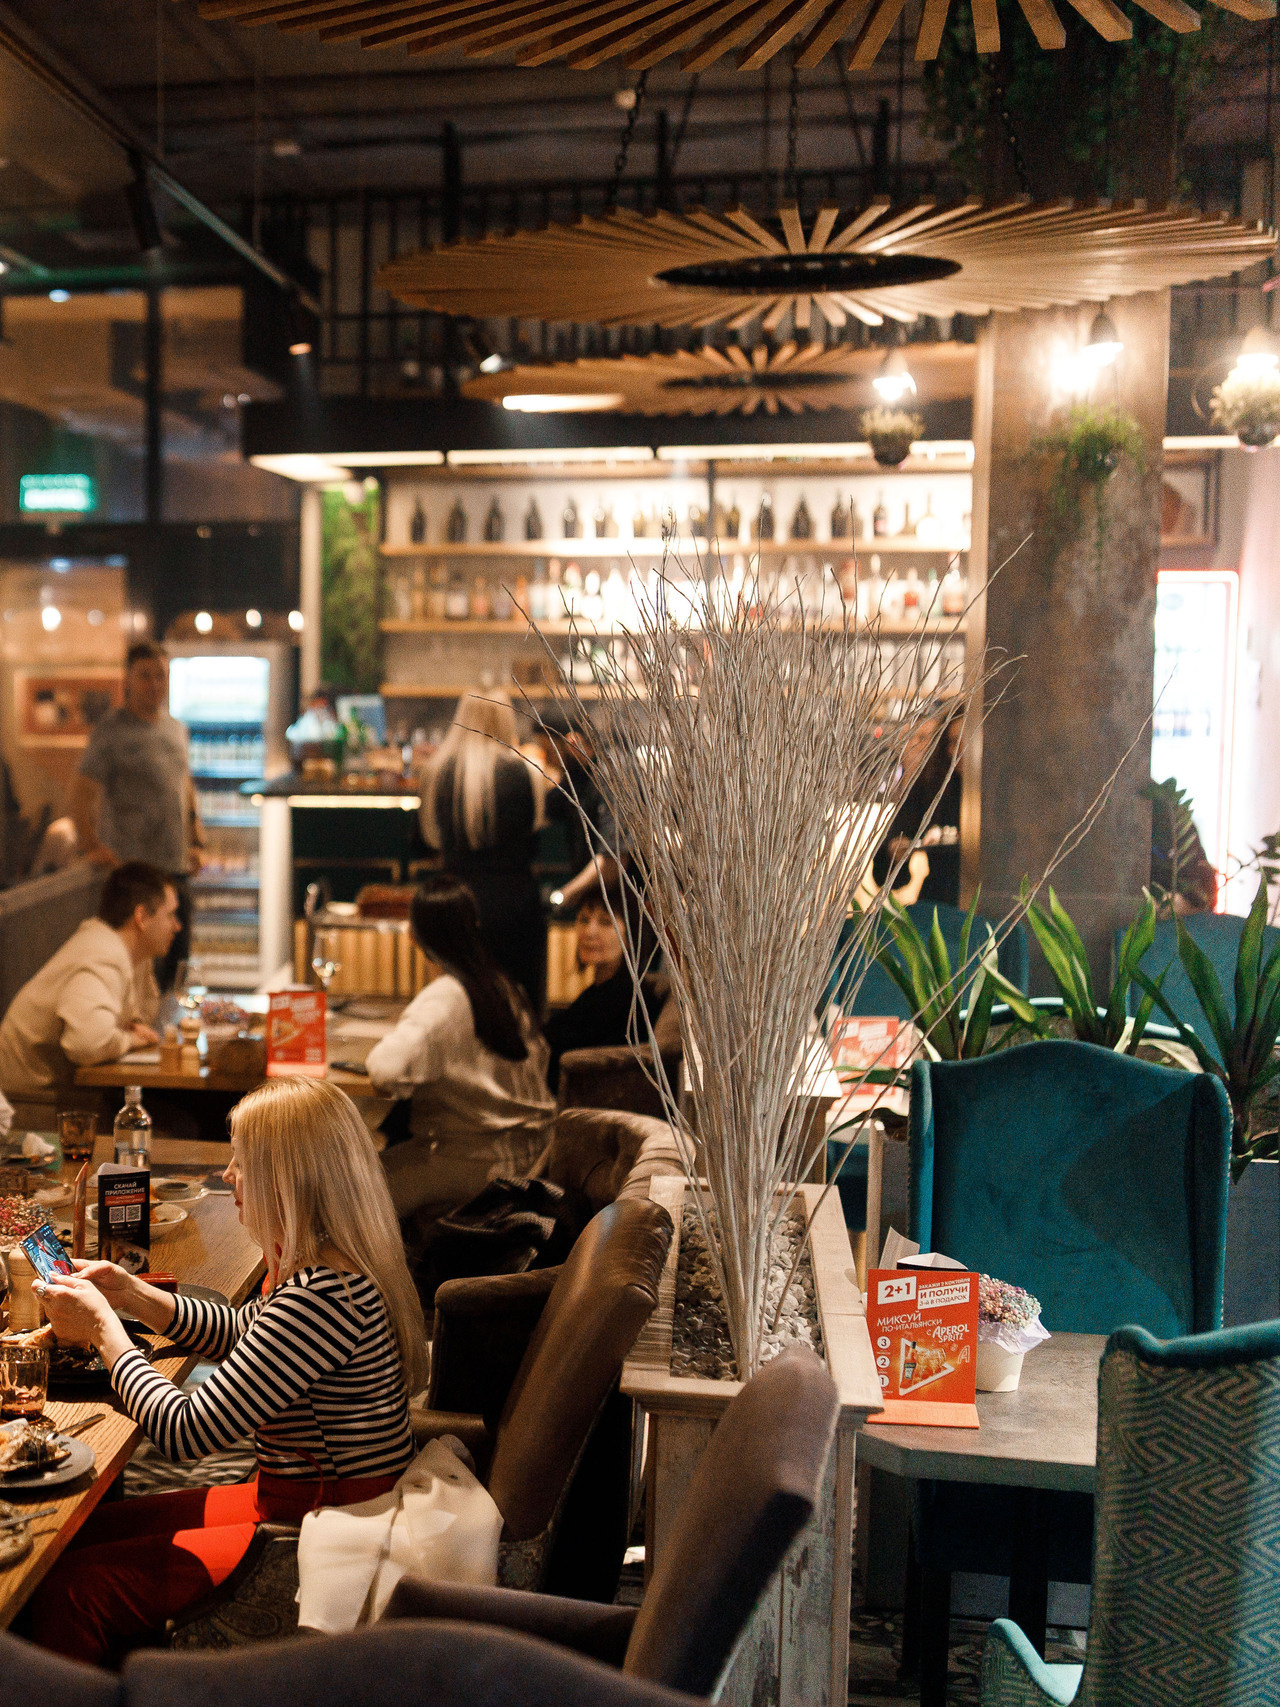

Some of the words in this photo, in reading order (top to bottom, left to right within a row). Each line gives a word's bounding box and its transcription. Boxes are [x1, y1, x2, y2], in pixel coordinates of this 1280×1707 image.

[105, 1187, 145, 1195] ПРИЛОЖЕНИЕ
[884, 1282, 911, 1298] 2+1
[929, 1286, 968, 1297] ПОЛУЧИ
[936, 1295, 967, 1304] ПОДАРОК
[877, 1310, 921, 1326] МИКСУЙ
[882, 1319, 942, 1332] ПО-ИТАЛЬЯНСКИ
[932, 1324, 970, 1338] APEROL
